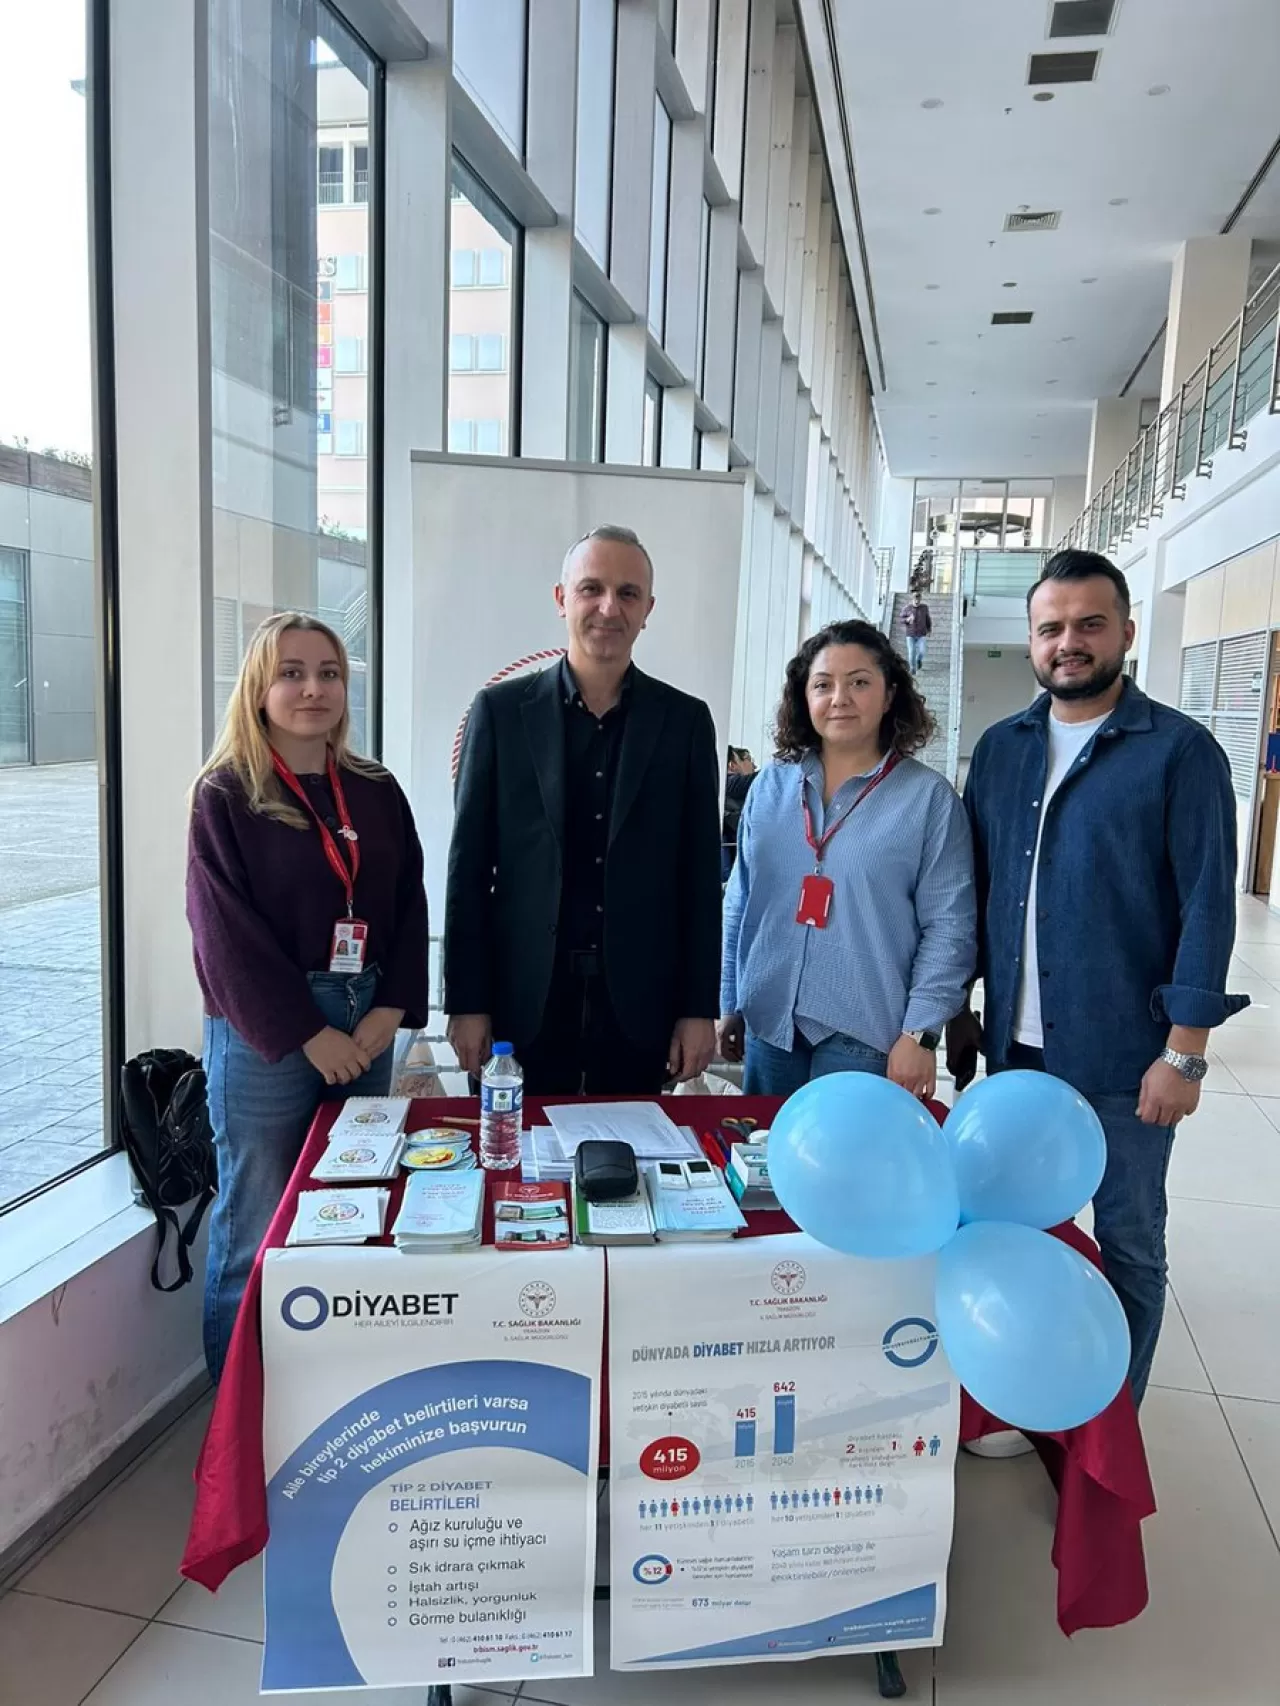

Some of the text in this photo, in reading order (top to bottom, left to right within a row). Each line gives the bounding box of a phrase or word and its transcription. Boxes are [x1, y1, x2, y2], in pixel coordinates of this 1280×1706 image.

[333, 1290, 459, 1317] DİYABET
[763, 1297, 789, 1306] SAĞLIK
[789, 1294, 828, 1304] BAKANLIĞI
[508, 1319, 537, 1328] SAĞLIK
[537, 1317, 581, 1327] BAKANLIĞI
[632, 1335, 835, 1362] DÜNYADA DİYABET HIZLA ARTIYOR
[773, 1381, 796, 1393] 642
[736, 1407, 756, 1419] 415
[317, 1394, 528, 1485] tip 2 diyabet belirtileri varsa
[360, 1419, 528, 1475] hekiminize başvurun
[845, 1443, 856, 1454] 2
[282, 1409, 381, 1500] Aile bireylerinde
[653, 1448, 688, 1464] 415
[772, 1456, 794, 1467] 2040
[653, 1465, 686, 1475] milyon
[390, 1480, 493, 1493] TİP 2 DİYABET
[390, 1494, 480, 1512] BELİRTİLERİ
[784, 1514, 794, 1522] 10
[410, 1516, 523, 1535] Ağız kuruluğu ve
[655, 1523, 662, 1531] 11
[409, 1532, 547, 1552] aşırı su içme ihtiyacı
[771, 1548, 800, 1559] Yaşam
[409, 1558, 526, 1574] Sık idrara çıkmak
[409, 1580, 479, 1594] İştah artışı
[409, 1591, 537, 1607] Halsizlik, yorgunluk
[692, 1597, 709, 1607] 673
[409, 1608, 527, 1626] Görme bulanıklığı
